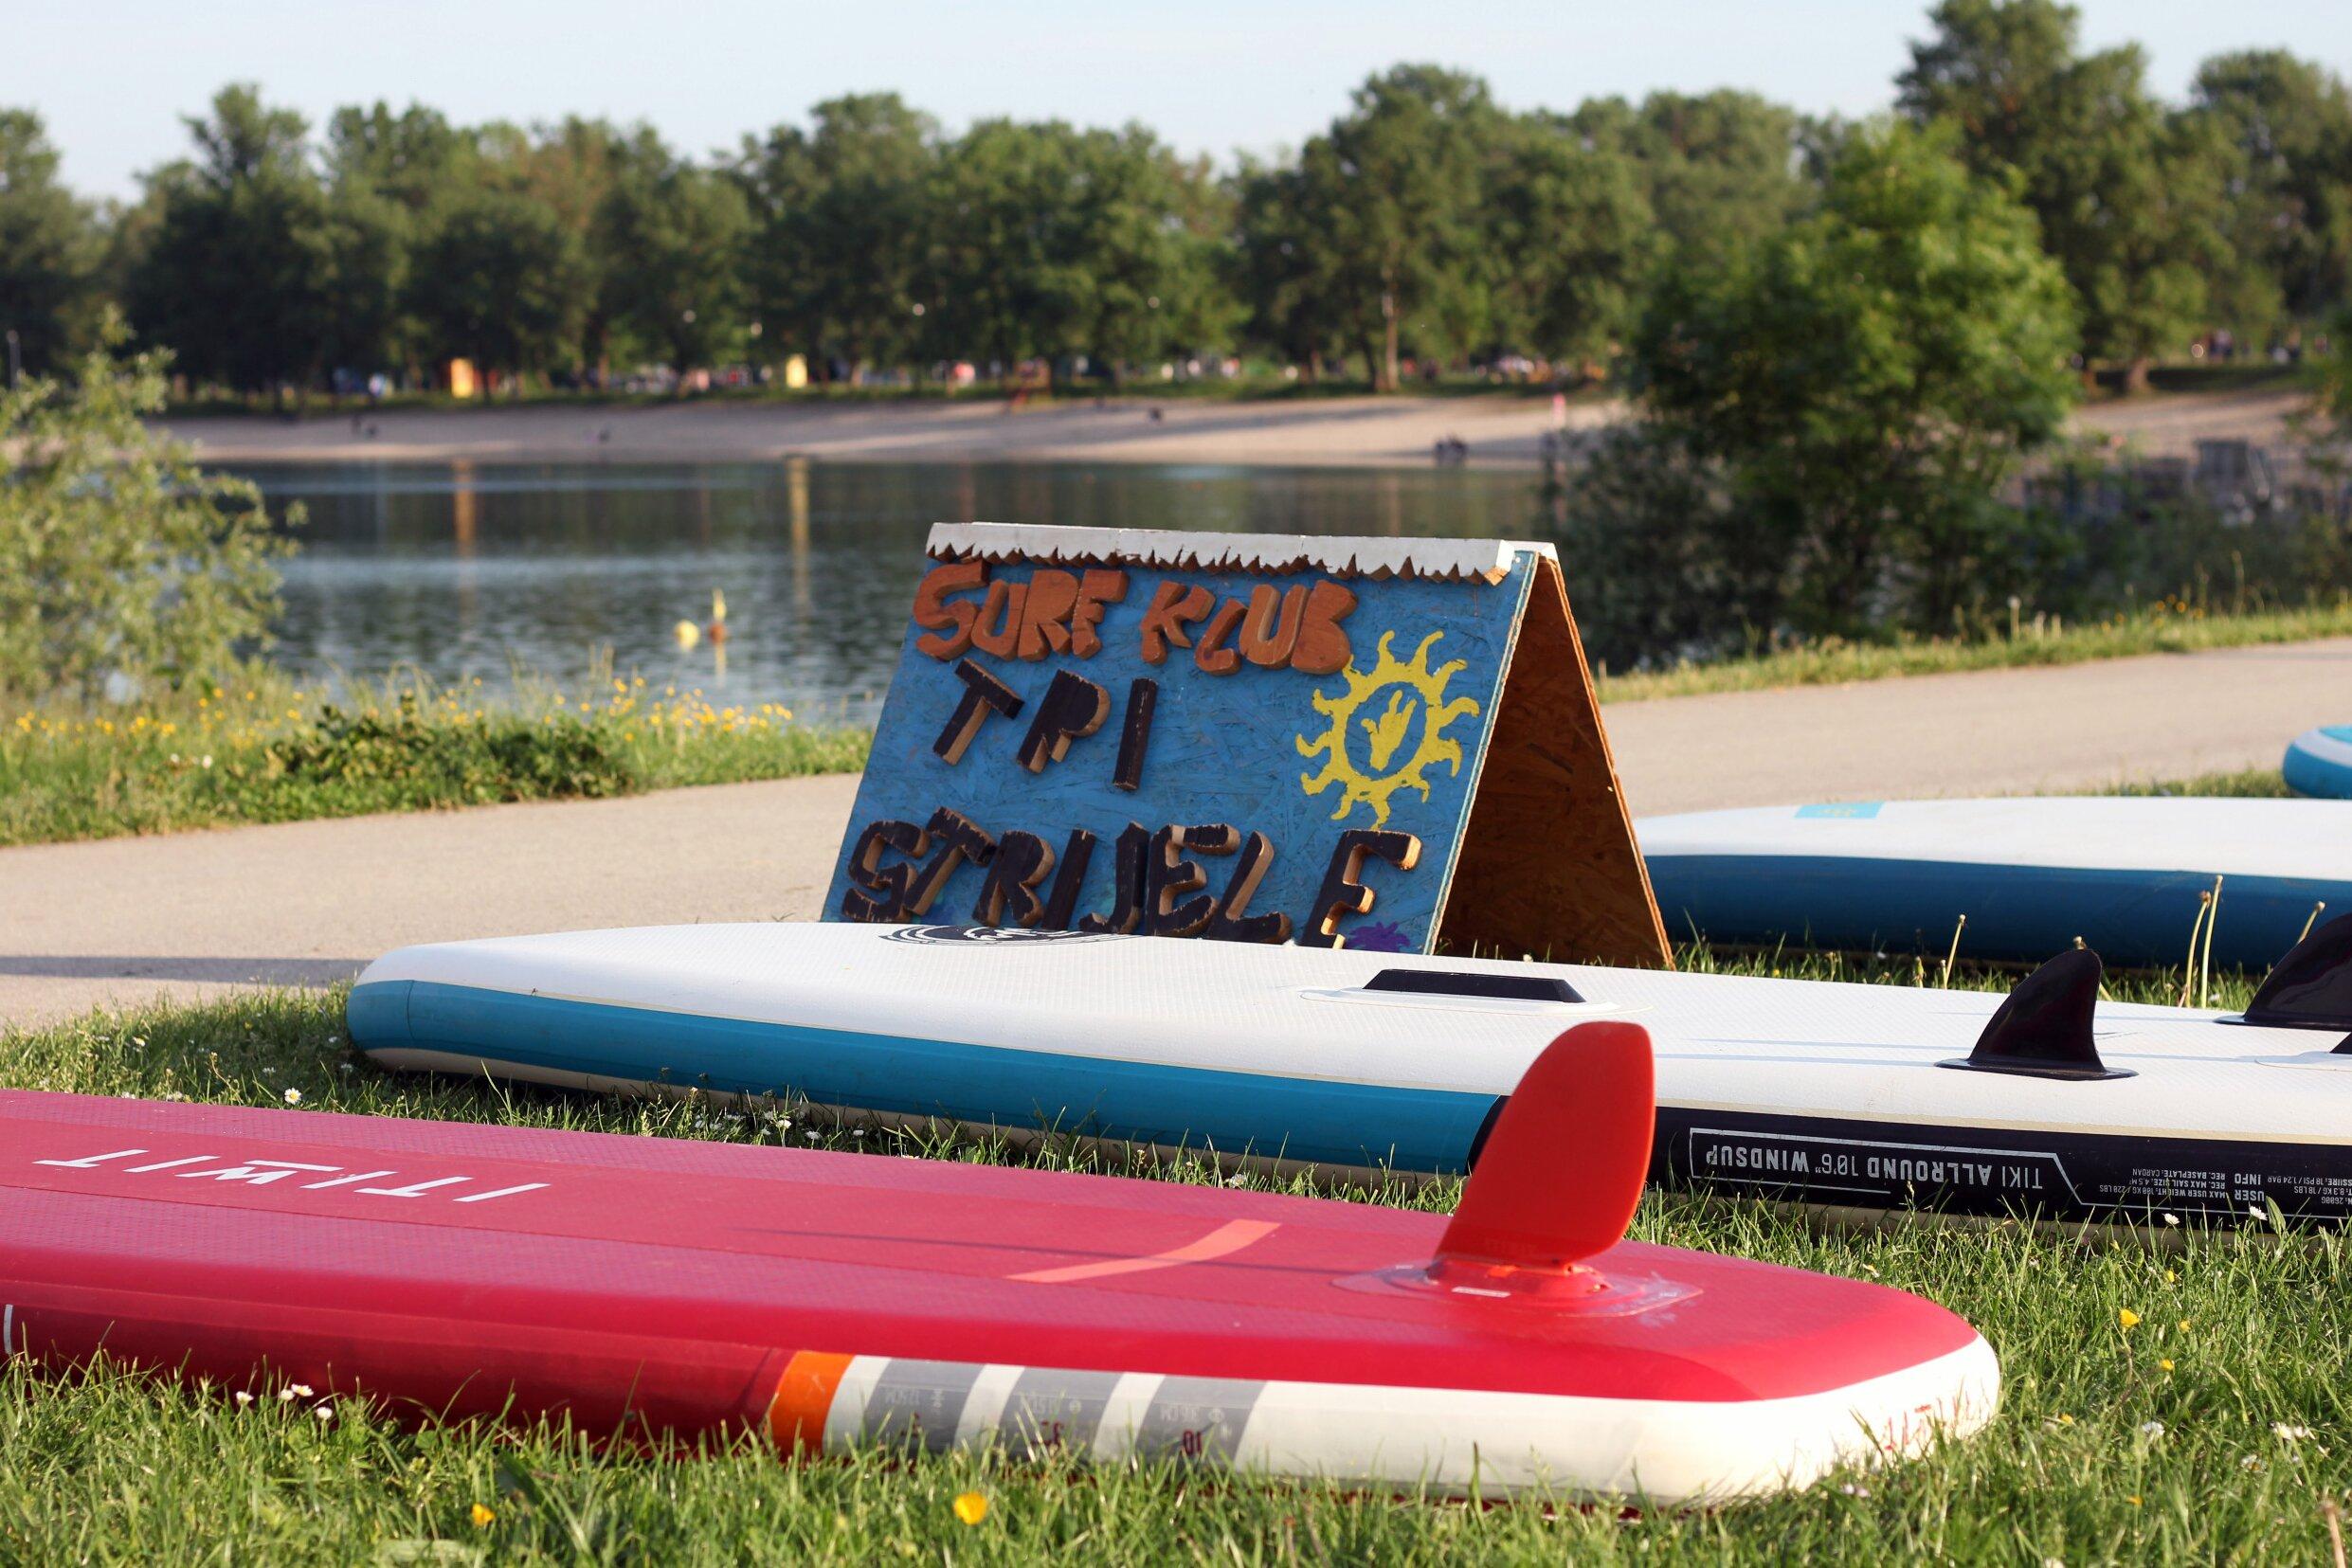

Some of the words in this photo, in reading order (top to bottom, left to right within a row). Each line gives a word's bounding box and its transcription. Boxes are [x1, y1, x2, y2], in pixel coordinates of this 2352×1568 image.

[913, 559, 1130, 662] SURF
[1139, 578, 1360, 676] KLUB
[932, 658, 1159, 792] TRI
[1705, 1144, 1809, 1172] WINDSUP
[32, 1148, 552, 1203] ITIWIT
[1867, 1157, 1992, 1186] ALLROUND
[2132, 1168, 2160, 1178] CARDAN
[2161, 1169, 2207, 1180] BASEPLATE:
[2208, 1172, 2226, 1181] REC.
[2001, 1166, 2043, 1189] TIKI
[2234, 1173, 2262, 1185] INFO
[2171, 1179, 2189, 1187] SAIL
[2190, 1180, 2207, 1189] MAX
[2208, 1181, 2226, 1189] REC.
[2099, 1184, 2112, 1193] LBS
[2187, 1189, 2207, 1198] USER
[2293, 1185, 2307, 1194] LBS
[2209, 1190, 2226, 1199] MAX
[2234, 1189, 2265, 1202] USER
